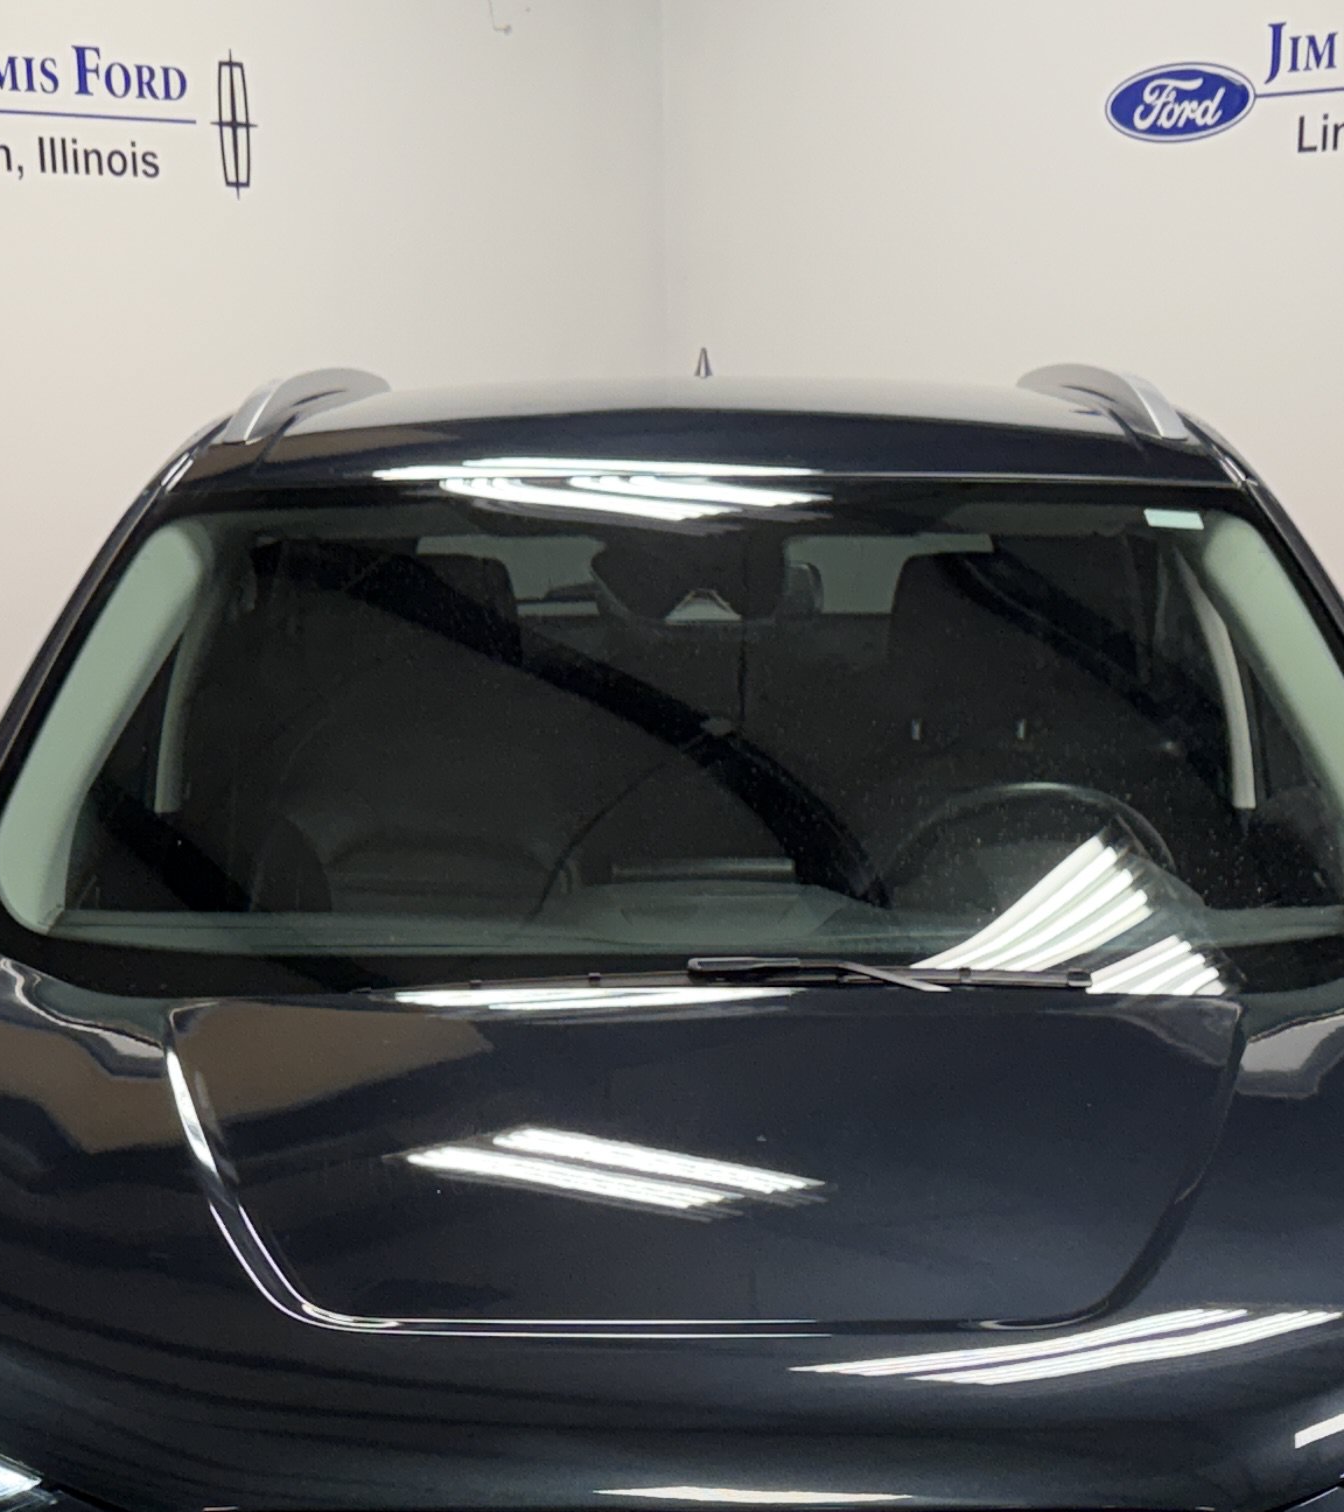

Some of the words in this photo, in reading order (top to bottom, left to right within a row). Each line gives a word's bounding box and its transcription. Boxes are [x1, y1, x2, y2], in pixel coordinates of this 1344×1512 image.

[72, 46, 187, 101] FORD
[1265, 22, 1337, 84] JIM
[1133, 78, 1224, 128] Ford
[38, 138, 160, 177] Illinois
